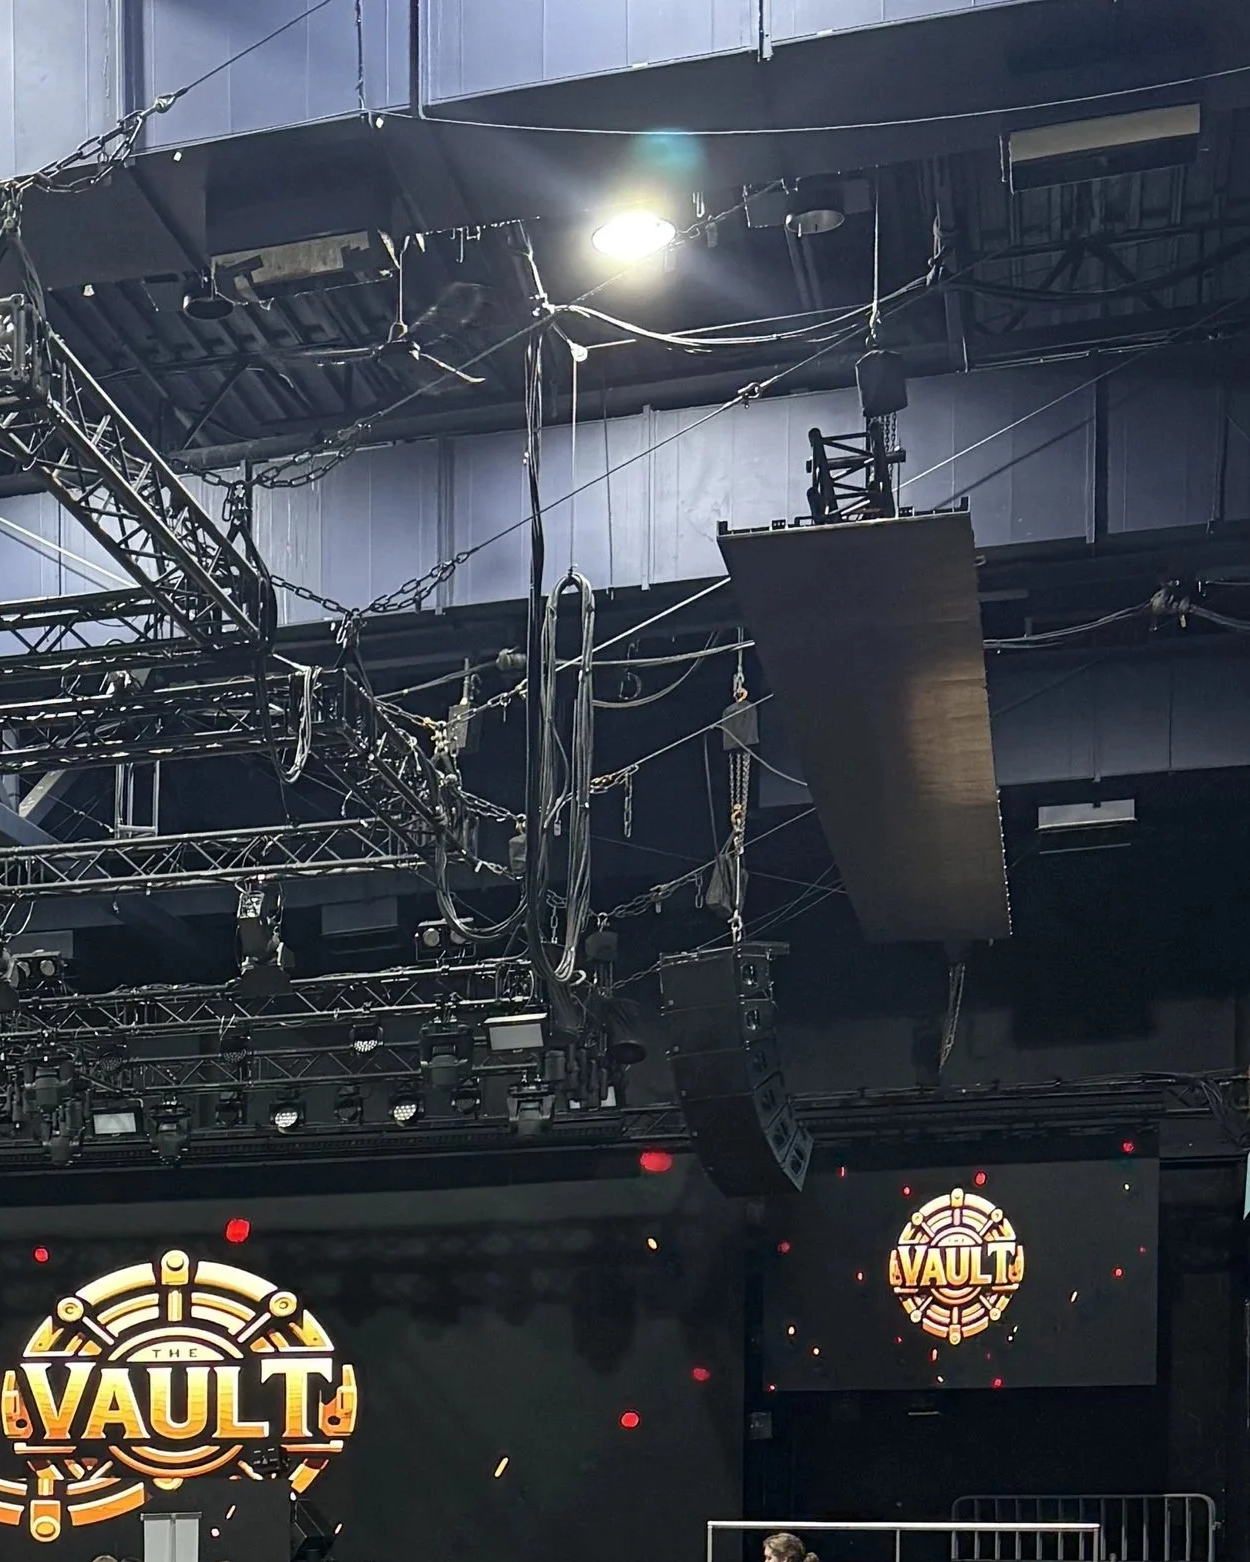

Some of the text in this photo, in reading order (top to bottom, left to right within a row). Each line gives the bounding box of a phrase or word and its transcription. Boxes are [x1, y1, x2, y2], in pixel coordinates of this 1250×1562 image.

[897, 1242, 1016, 1287] VAULT
[151, 1347, 198, 1360] THE
[19, 1357, 333, 1440] VAULT
